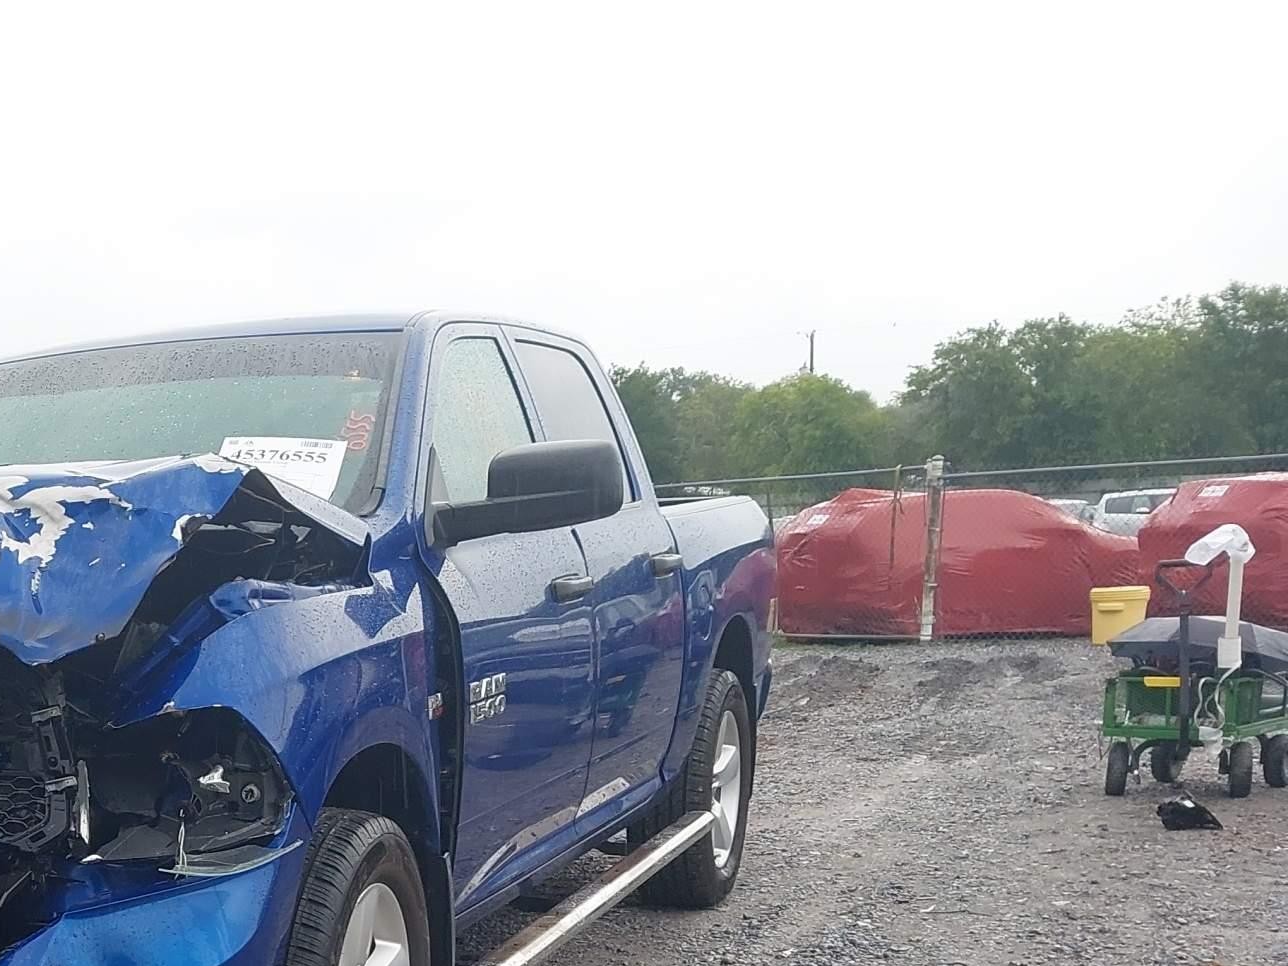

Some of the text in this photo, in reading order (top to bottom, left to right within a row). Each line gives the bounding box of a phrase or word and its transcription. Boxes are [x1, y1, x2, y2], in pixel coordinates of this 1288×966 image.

[231, 449, 329, 464] 45376555
[470, 672, 507, 703] RAM
[470, 694, 507, 724] 1500
